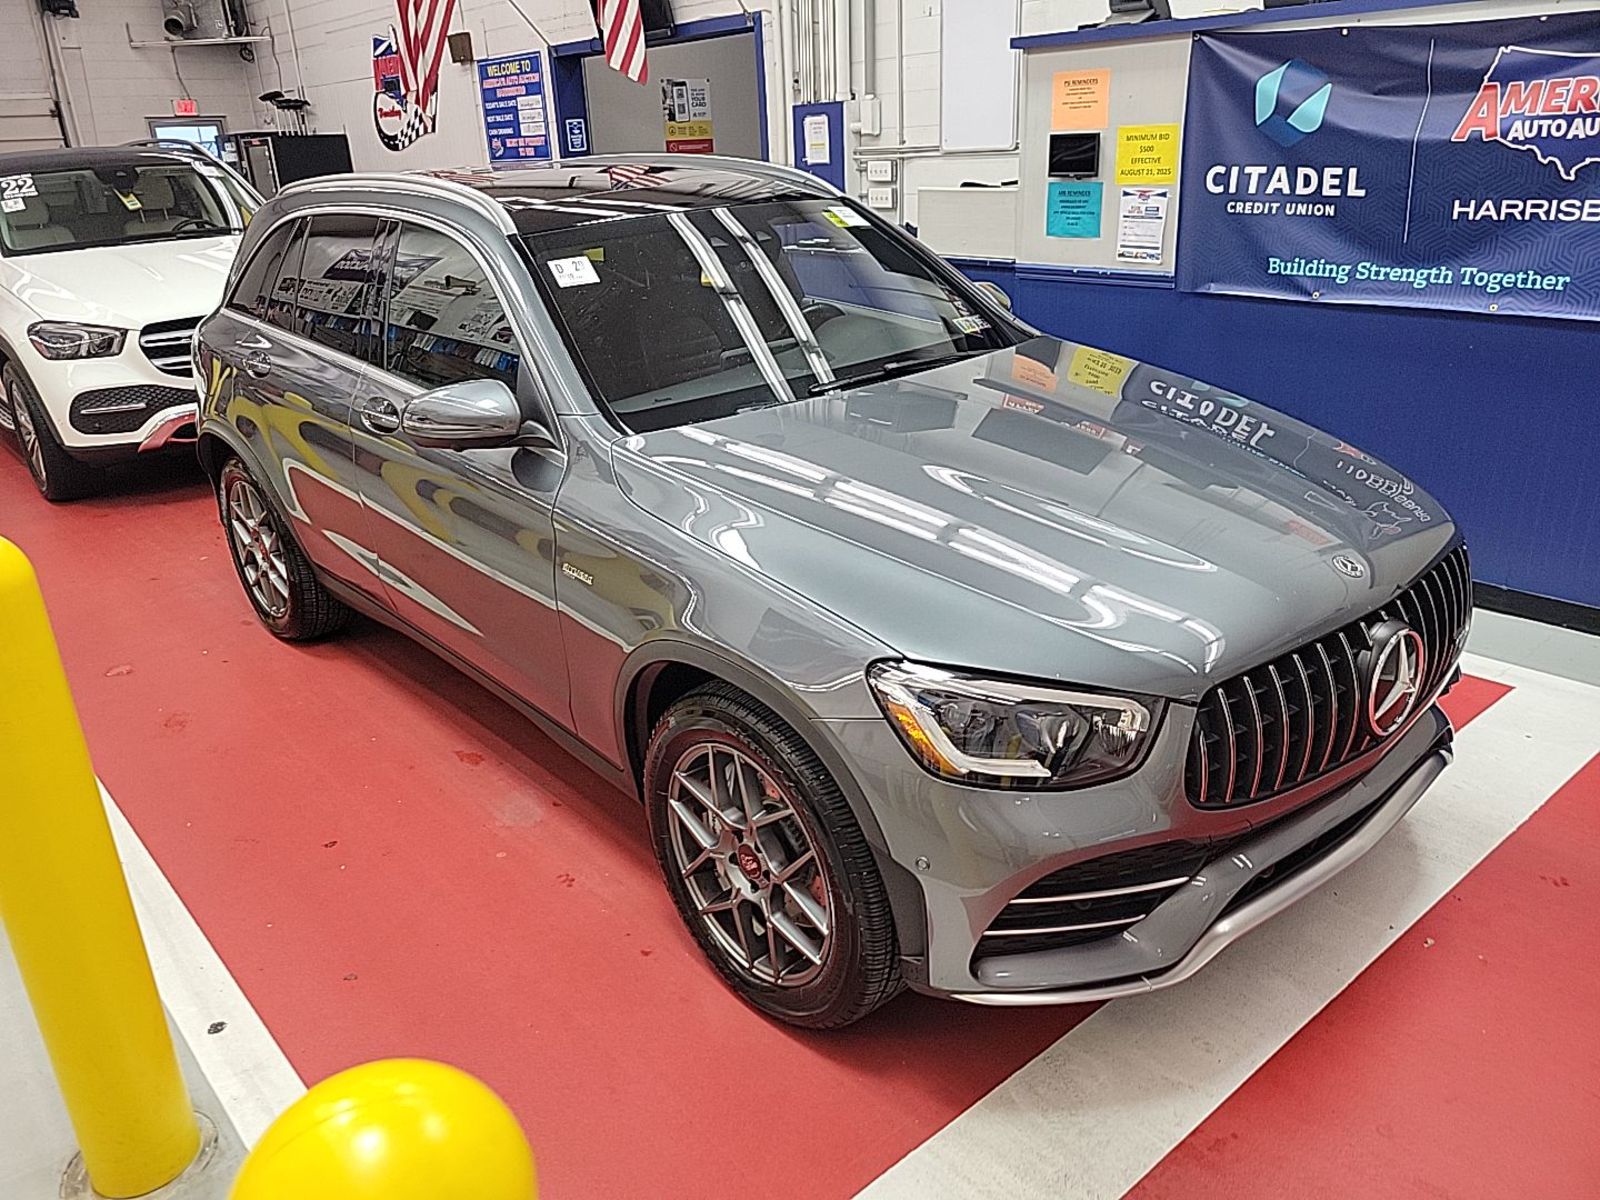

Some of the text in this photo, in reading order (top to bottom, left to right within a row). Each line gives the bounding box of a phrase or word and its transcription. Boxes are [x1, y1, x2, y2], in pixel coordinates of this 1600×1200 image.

[487, 60, 531, 77] WELCOME TO
[1451, 77, 1600, 141] AMER
[1126, 133, 1157, 141] MINIMUM
[1507, 118, 1568, 141] AUTO
[1, 178, 36, 195] 22
[1206, 165, 1366, 197] CITADEL
[1227, 202, 1335, 216] CREDIT UNION
[1267, 257, 1570, 293] Building Strength Together
